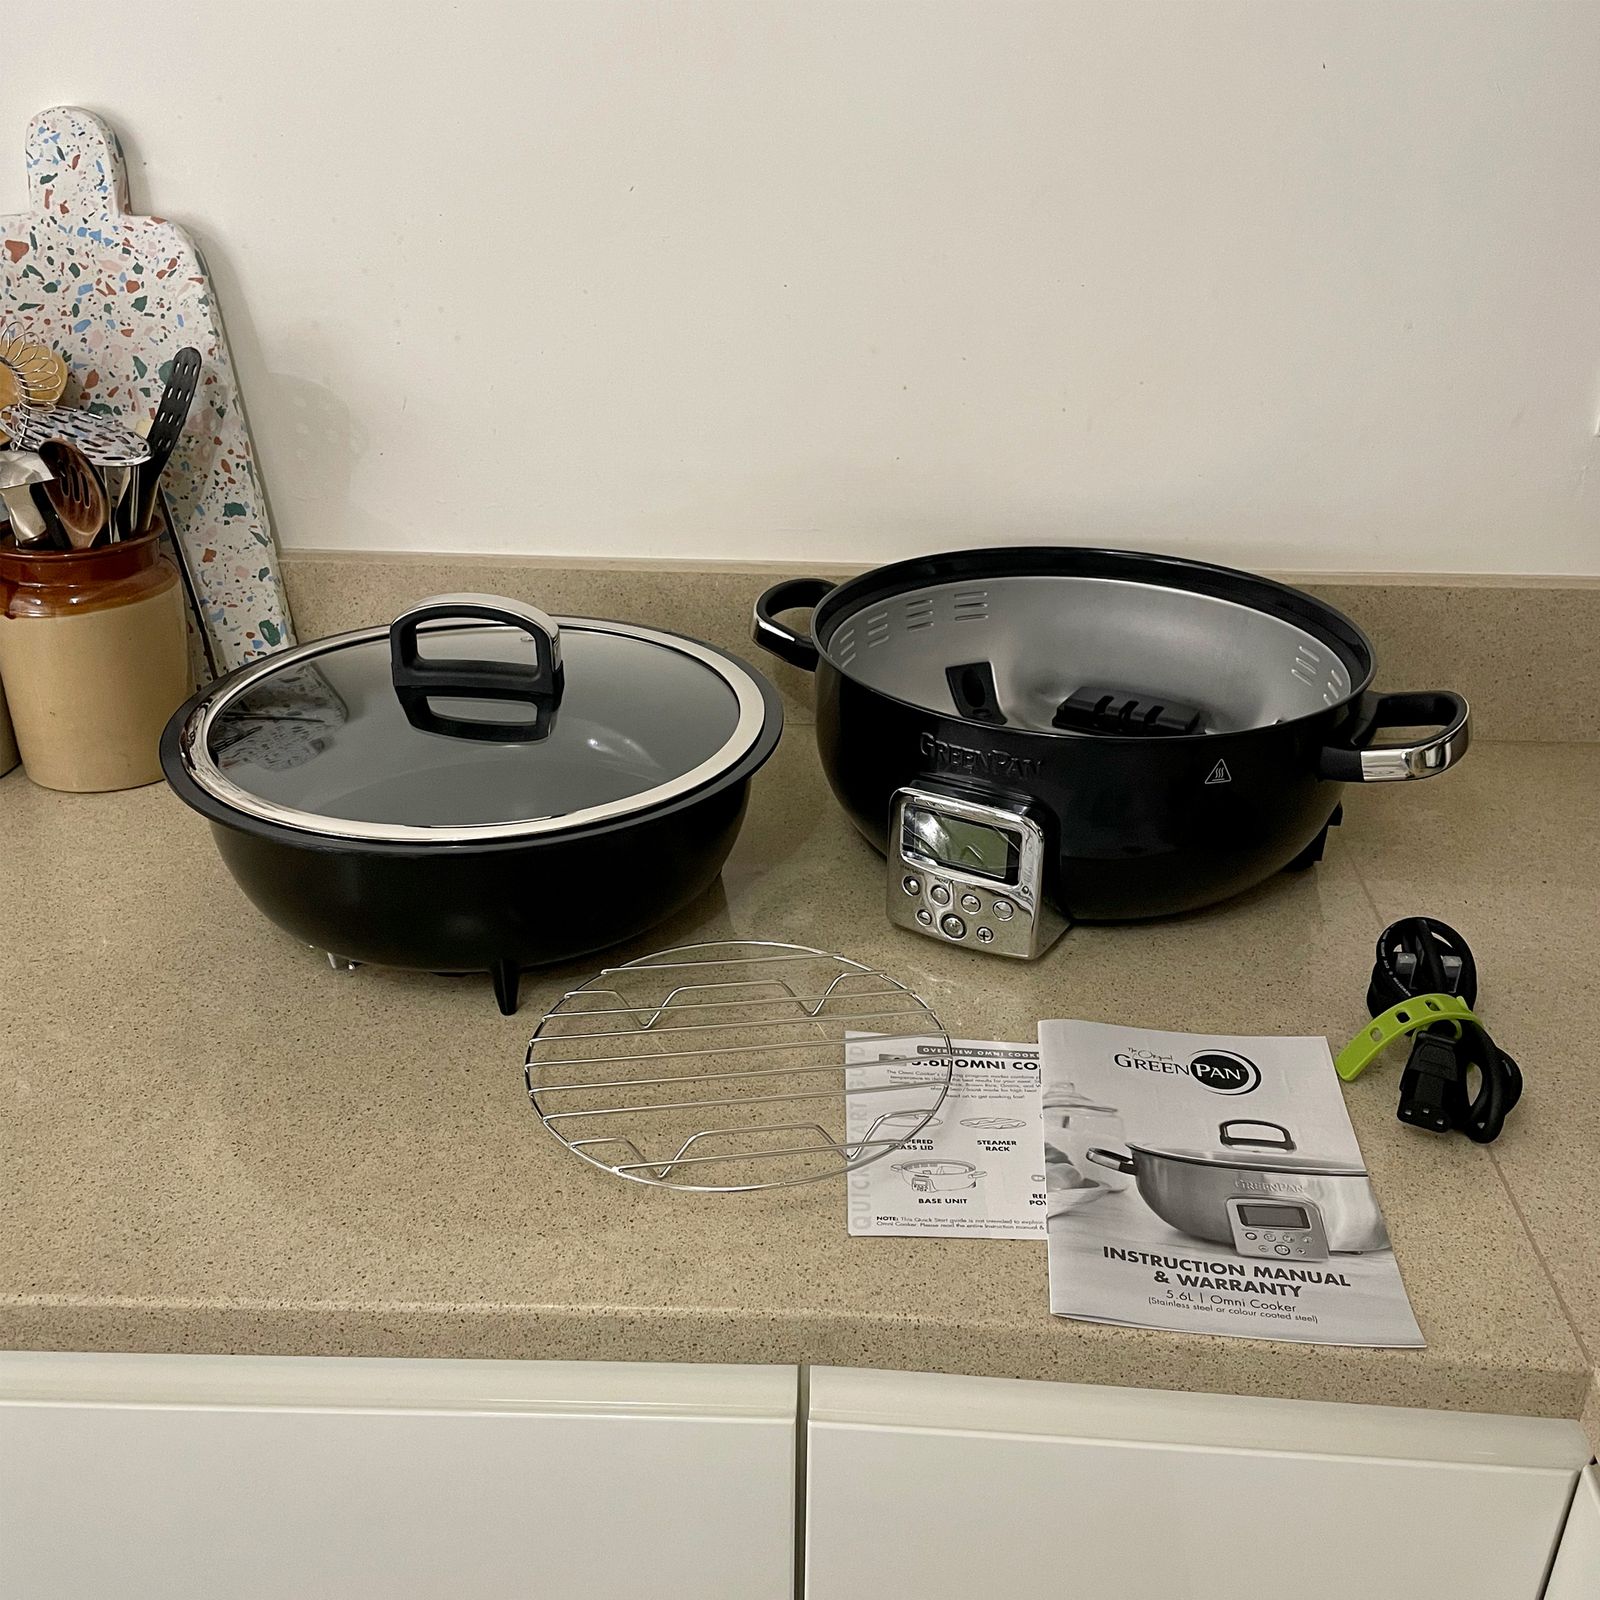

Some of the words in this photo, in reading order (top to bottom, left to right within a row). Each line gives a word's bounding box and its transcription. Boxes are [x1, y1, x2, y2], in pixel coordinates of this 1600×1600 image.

[954, 1059, 1006, 1070] OMNI
[1103, 1246, 1246, 1276] INSTRUCTION
[1253, 1265, 1351, 1287] MANUAL
[1153, 1270, 1170, 1284] &
[1176, 1273, 1302, 1298] WARRANTY
[1148, 1296, 1190, 1309] (Stainless
[1193, 1303, 1213, 1312] steel
[1228, 1307, 1257, 1316] colour
[1260, 1311, 1292, 1320] coated
[1166, 1289, 1194, 1302] 5.6L
[1210, 1294, 1246, 1307] Omni
[1249, 1298, 1297, 1313] Cooker
